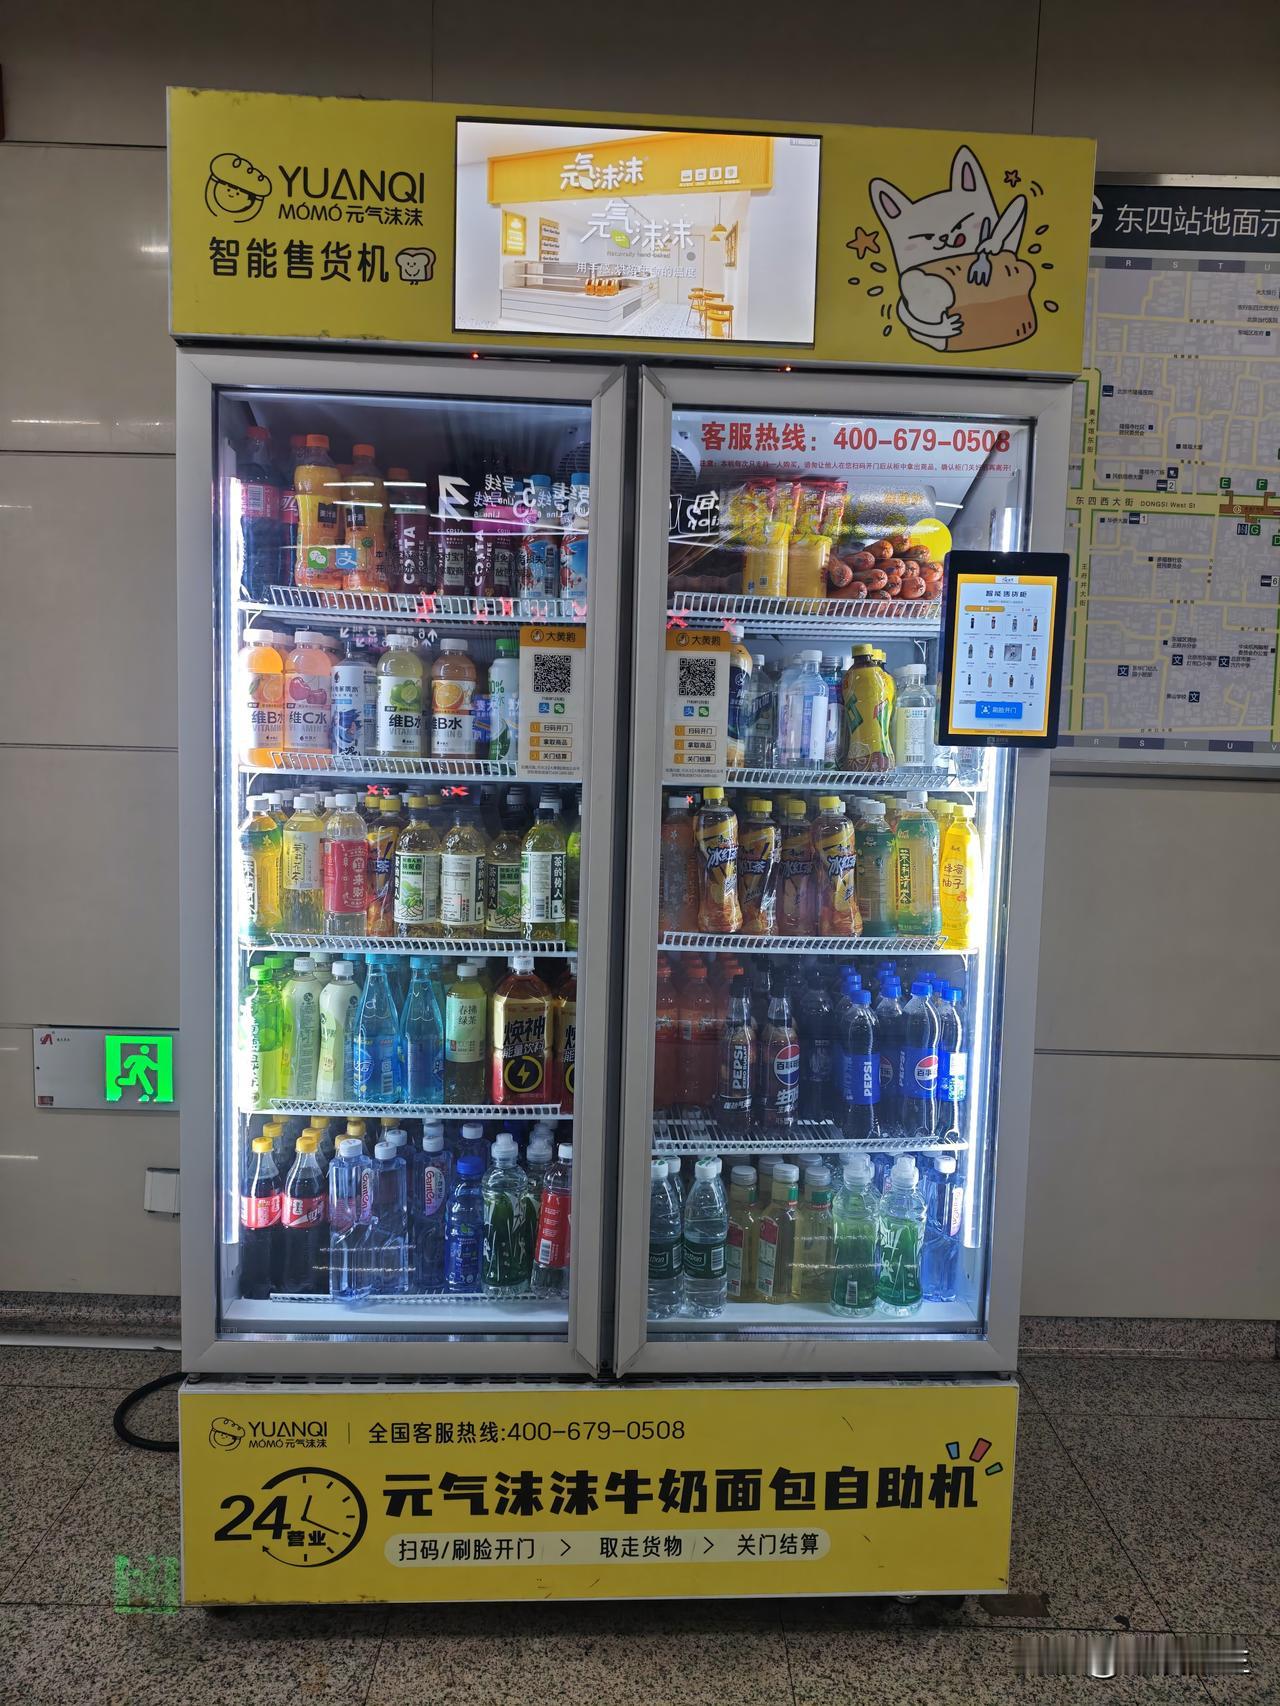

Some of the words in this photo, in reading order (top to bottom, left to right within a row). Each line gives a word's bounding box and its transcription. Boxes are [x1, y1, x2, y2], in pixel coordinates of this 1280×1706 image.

[278, 165, 425, 203] YUANQI
[560, 152, 644, 192] 元气沫沫
[346, 205, 424, 227] 元气沫沫
[580, 200, 695, 250] 元气沫沫
[1115, 204, 1280, 238] 东四站地面示
[208, 237, 389, 283] 智能售货机
[1172, 261, 1178, 269] S
[1218, 262, 1224, 270] T
[1264, 263, 1270, 271] U
[701, 421, 817, 452] 客服热线：
[833, 426, 1010, 453] 400-679-0508
[1168, 482, 1174, 490] 2
[1222, 479, 1229, 488] E
[1258, 480, 1265, 489] F
[1076, 496, 1134, 506] 东四西大街
[1140, 500, 1168, 508] DONGSI
[289, 711, 328, 724] 维C水
[554, 856, 563, 898] 茶的传人
[732, 1045, 743, 1090] PEPSI
[864, 1062, 872, 1097] PEPSI
[248, 1420, 328, 1438] YUANQI
[368, 1420, 686, 1445] 全国客服热线:400-679-0508
[285, 1438, 328, 1449] 元气沫沫
[382, 1464, 979, 1518] 元气沫沫牛奶面包自助机
[214, 1494, 291, 1542] 24
[286, 1530, 327, 1547] 营业
[398, 1538, 536, 1562] 扫码/刷脸开门
[599, 1535, 683, 1559] 取走货物
[736, 1532, 820, 1557] 关门结算
